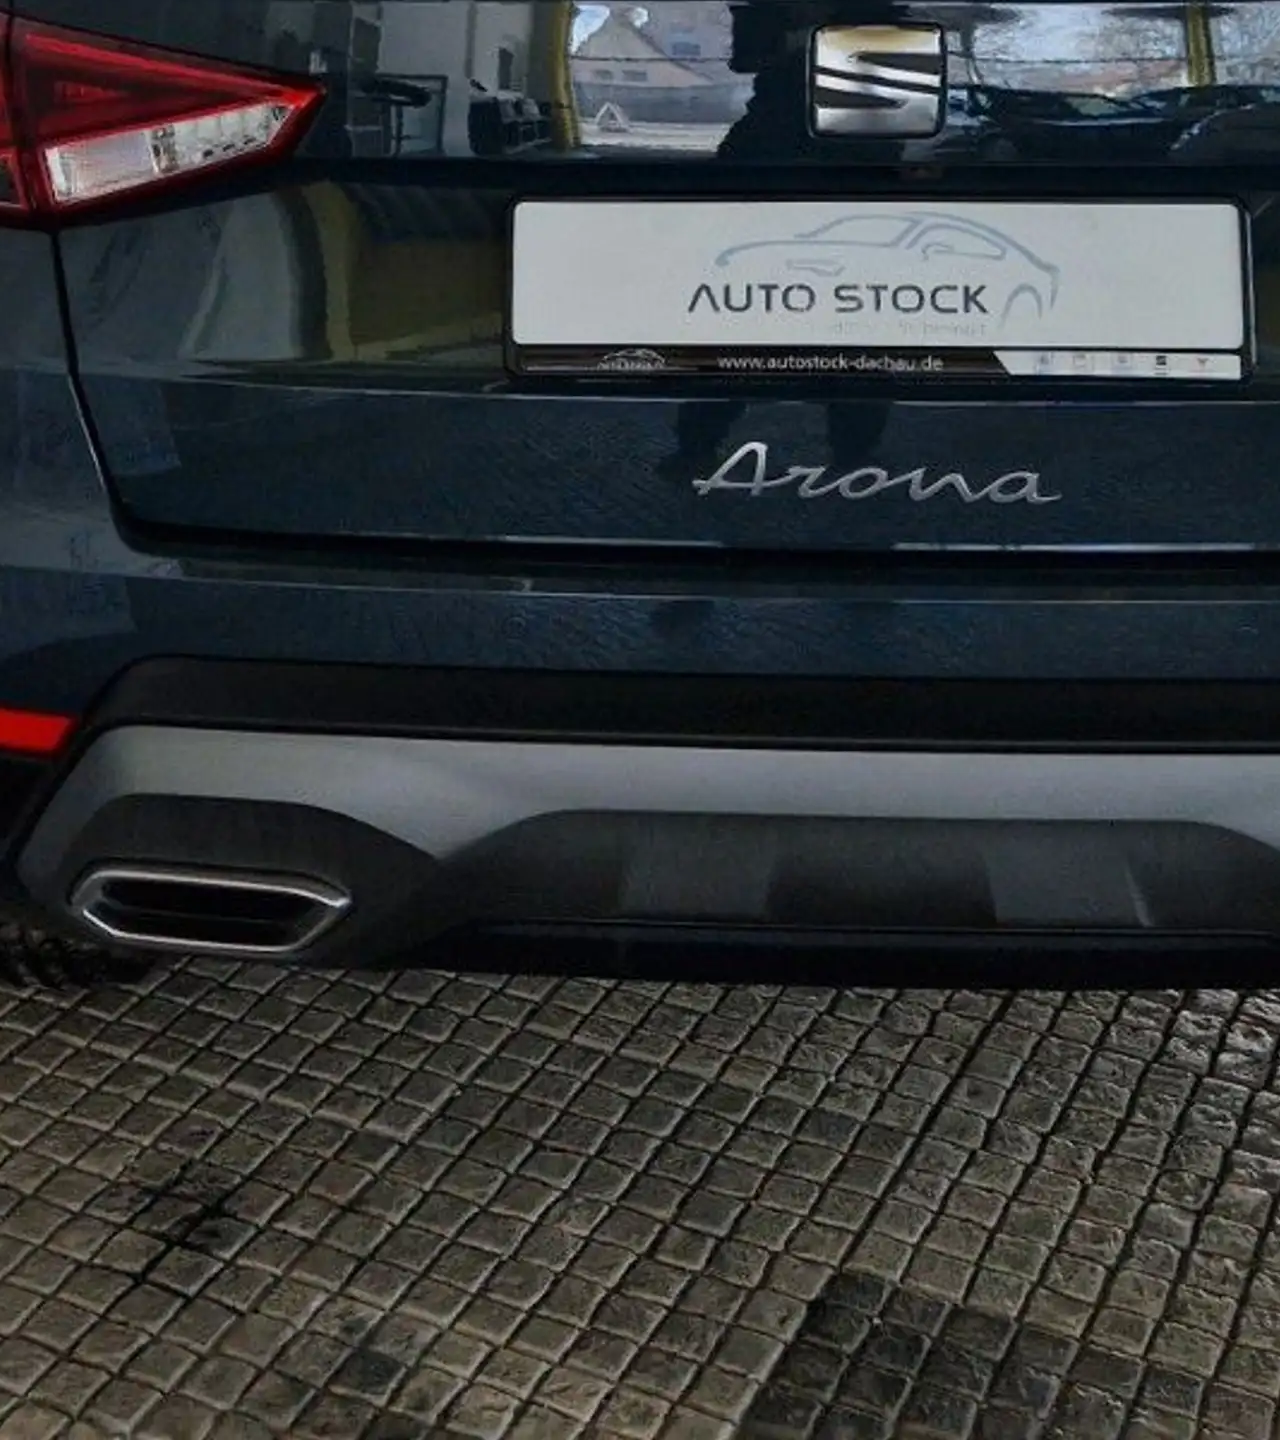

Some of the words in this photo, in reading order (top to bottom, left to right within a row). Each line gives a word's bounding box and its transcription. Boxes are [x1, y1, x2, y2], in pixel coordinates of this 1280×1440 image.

[688, 283, 816, 313] AUTO
[834, 283, 989, 314] STOCK
[717, 352, 944, 372] www.autostock-dachau.de
[691, 440, 1062, 504] Arona
